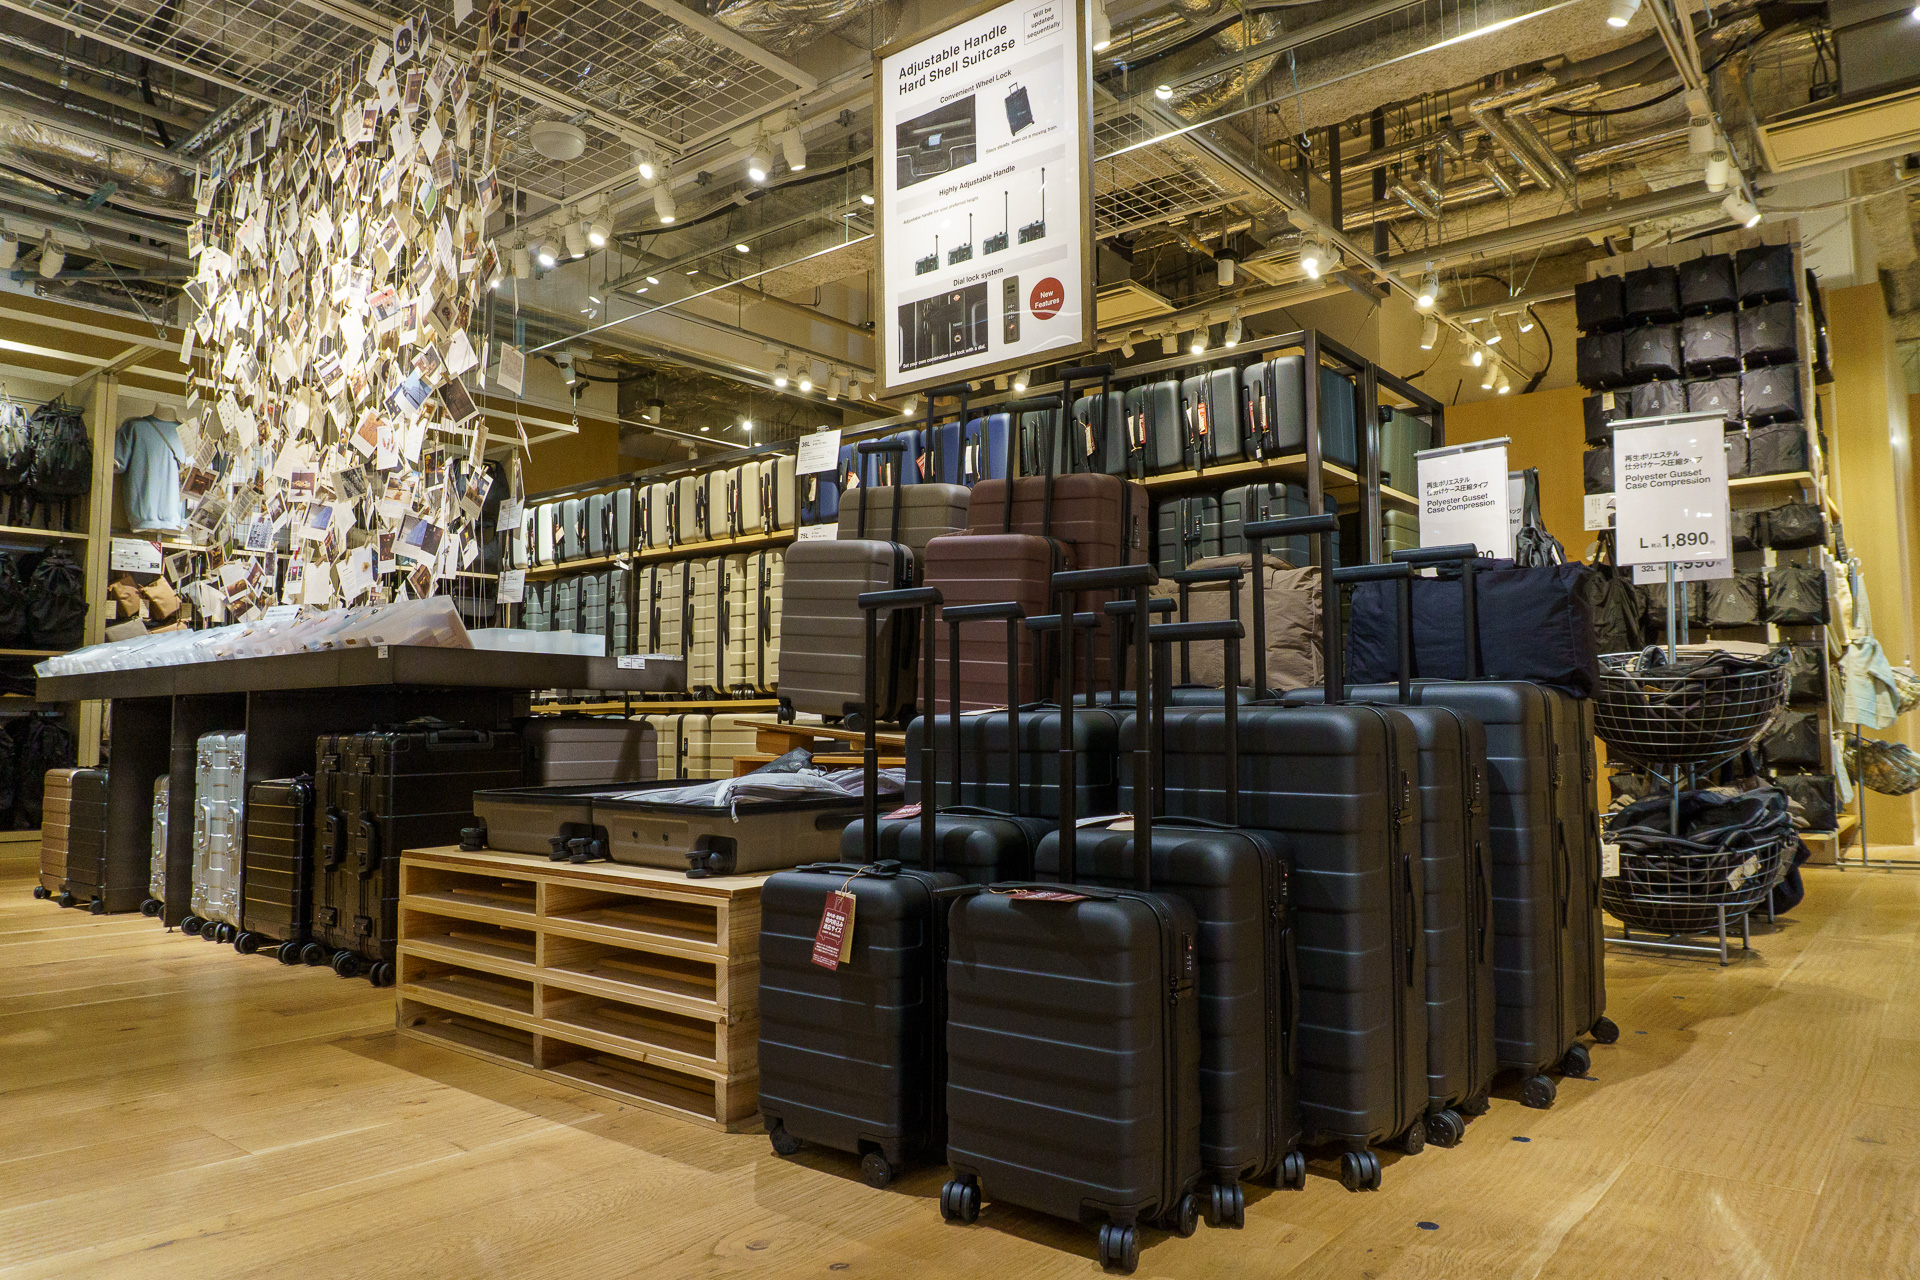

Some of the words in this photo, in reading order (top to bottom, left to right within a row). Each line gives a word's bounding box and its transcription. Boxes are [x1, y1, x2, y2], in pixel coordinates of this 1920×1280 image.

[1032, 9, 1043, 18] Will
[1031, 14, 1055, 28] updated
[1027, 21, 1060, 39] sequentially
[899, 46, 960, 79] Adjustable
[964, 25, 1007, 51] Handle
[899, 75, 926, 95] Hard
[929, 61, 958, 82] Shell
[962, 39, 1015, 68] Suitcase
[940, 85, 975, 103] Convenient
[975, 76, 995, 89] Wheel
[995, 69, 1012, 80] Lock
[939, 185, 958, 196] Highly
[959, 174, 992, 189] Adjustable
[993, 165, 1016, 178] Handle
[953, 277, 965, 286] Dial
[966, 274, 980, 283] lock
[980, 267, 1004, 279] system
[1040, 290, 1054, 299] New
[1034, 297, 1060, 309] Features
[1624, 450, 1680, 462] 再生ポリエステル
[1624, 455, 1703, 471] 仕分けケース圧縮タプ
[1426, 476, 1471, 489] 再生ポリエステル
[1625, 472, 1668, 483] Polyester
[1670, 469, 1702, 478] Gusset
[1625, 482, 1648, 490] Case
[1650, 476, 1711, 488] Compression
[1427, 497, 1461, 507] Polyester
[1462, 493, 1488, 502] Gusset
[1446, 500, 1496, 511] Compression
[1640, 537, 1649, 549] L
[1662, 531, 1709, 549] 1,890
[1641, 565, 1656, 573] 32L
[1673, 561, 1715, 573] ,990
